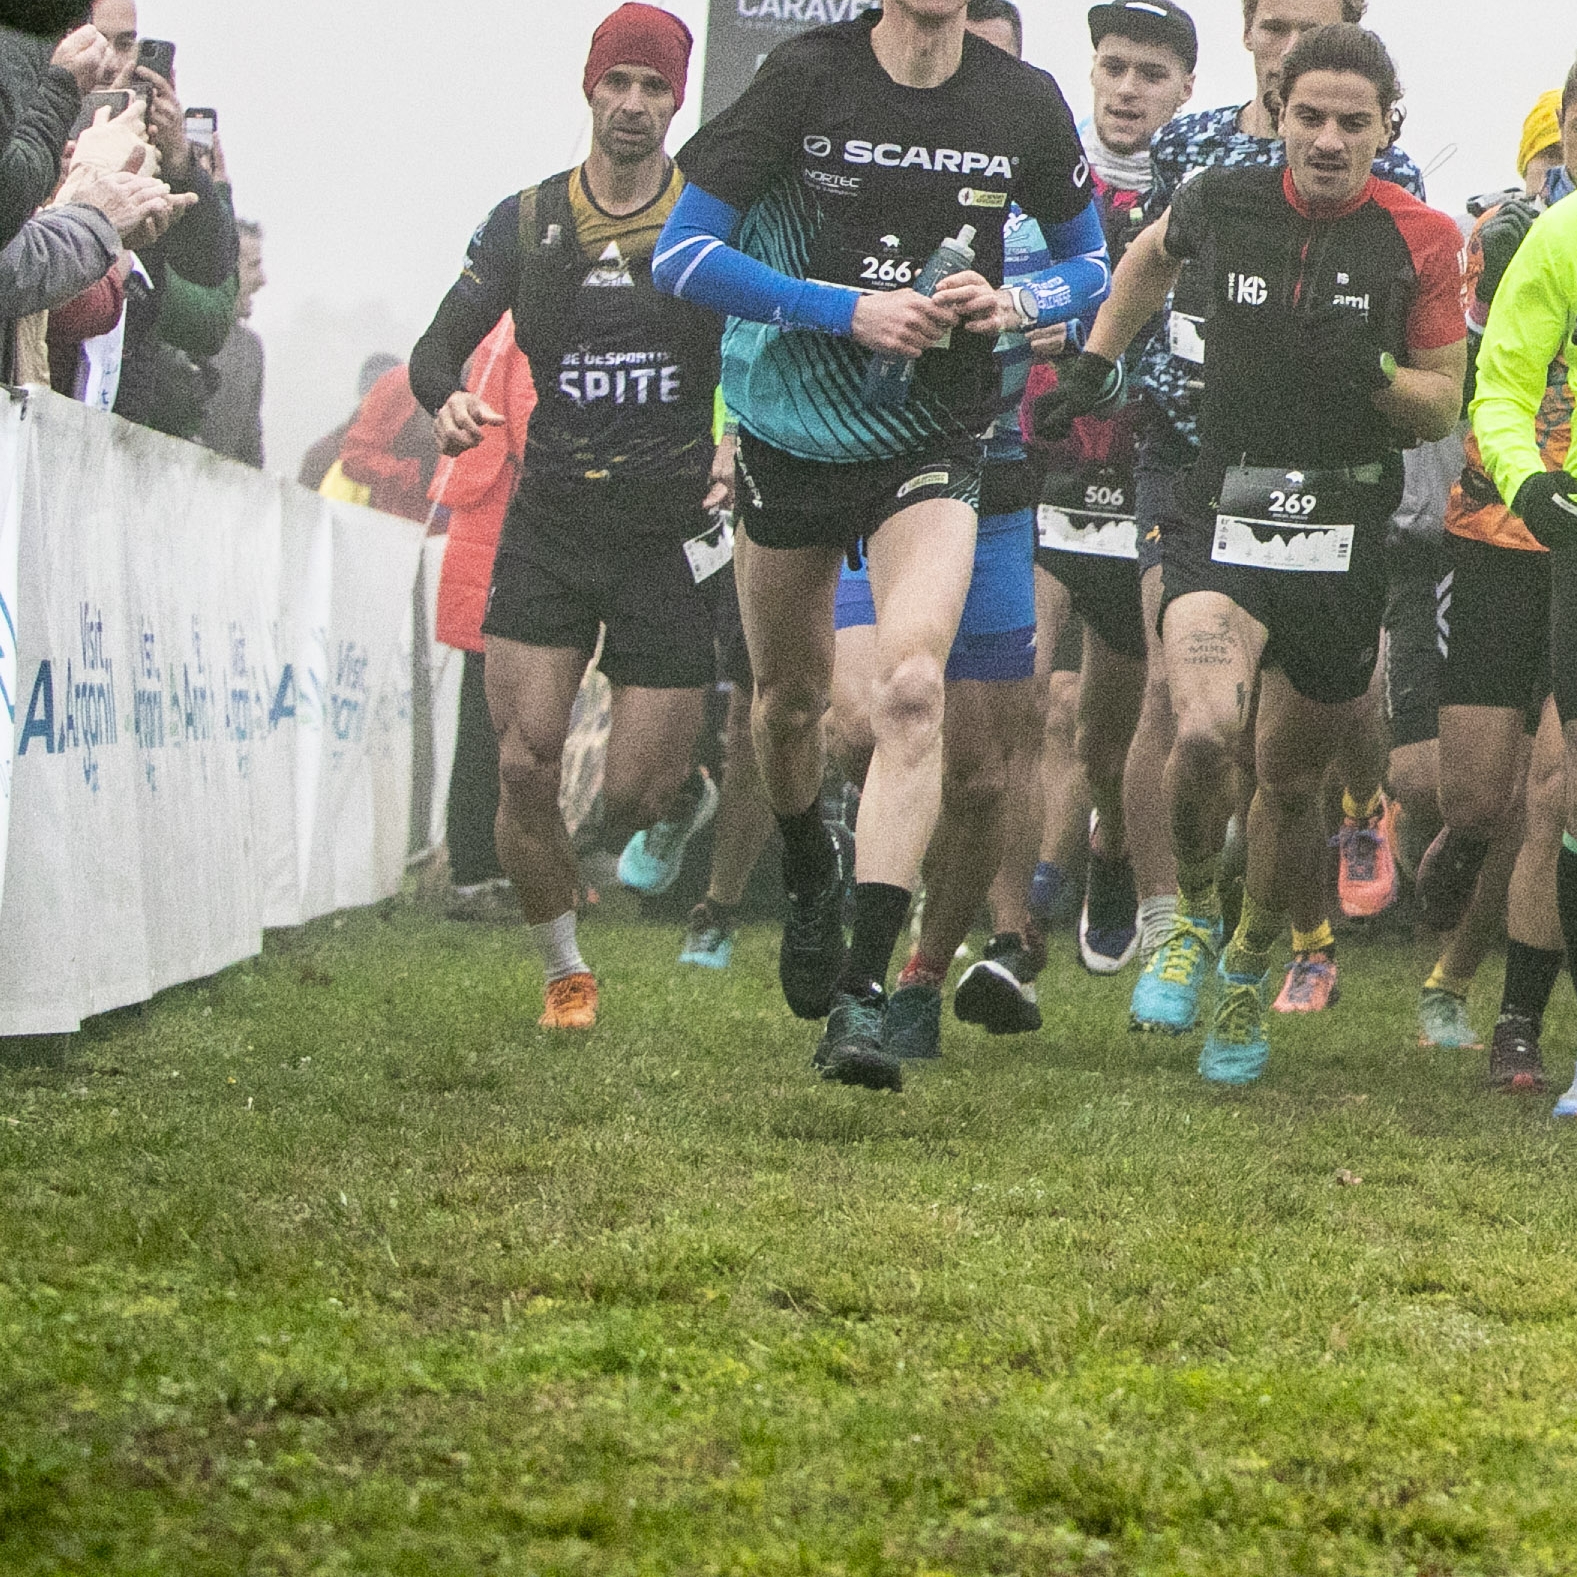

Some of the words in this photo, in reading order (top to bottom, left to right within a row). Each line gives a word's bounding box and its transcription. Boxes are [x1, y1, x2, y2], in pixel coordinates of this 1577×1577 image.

[843, 138, 1012, 180] SCARPA
[860, 255, 913, 283] 266
[1085, 485, 1125, 507] 506
[1267, 490, 1317, 515] 269
